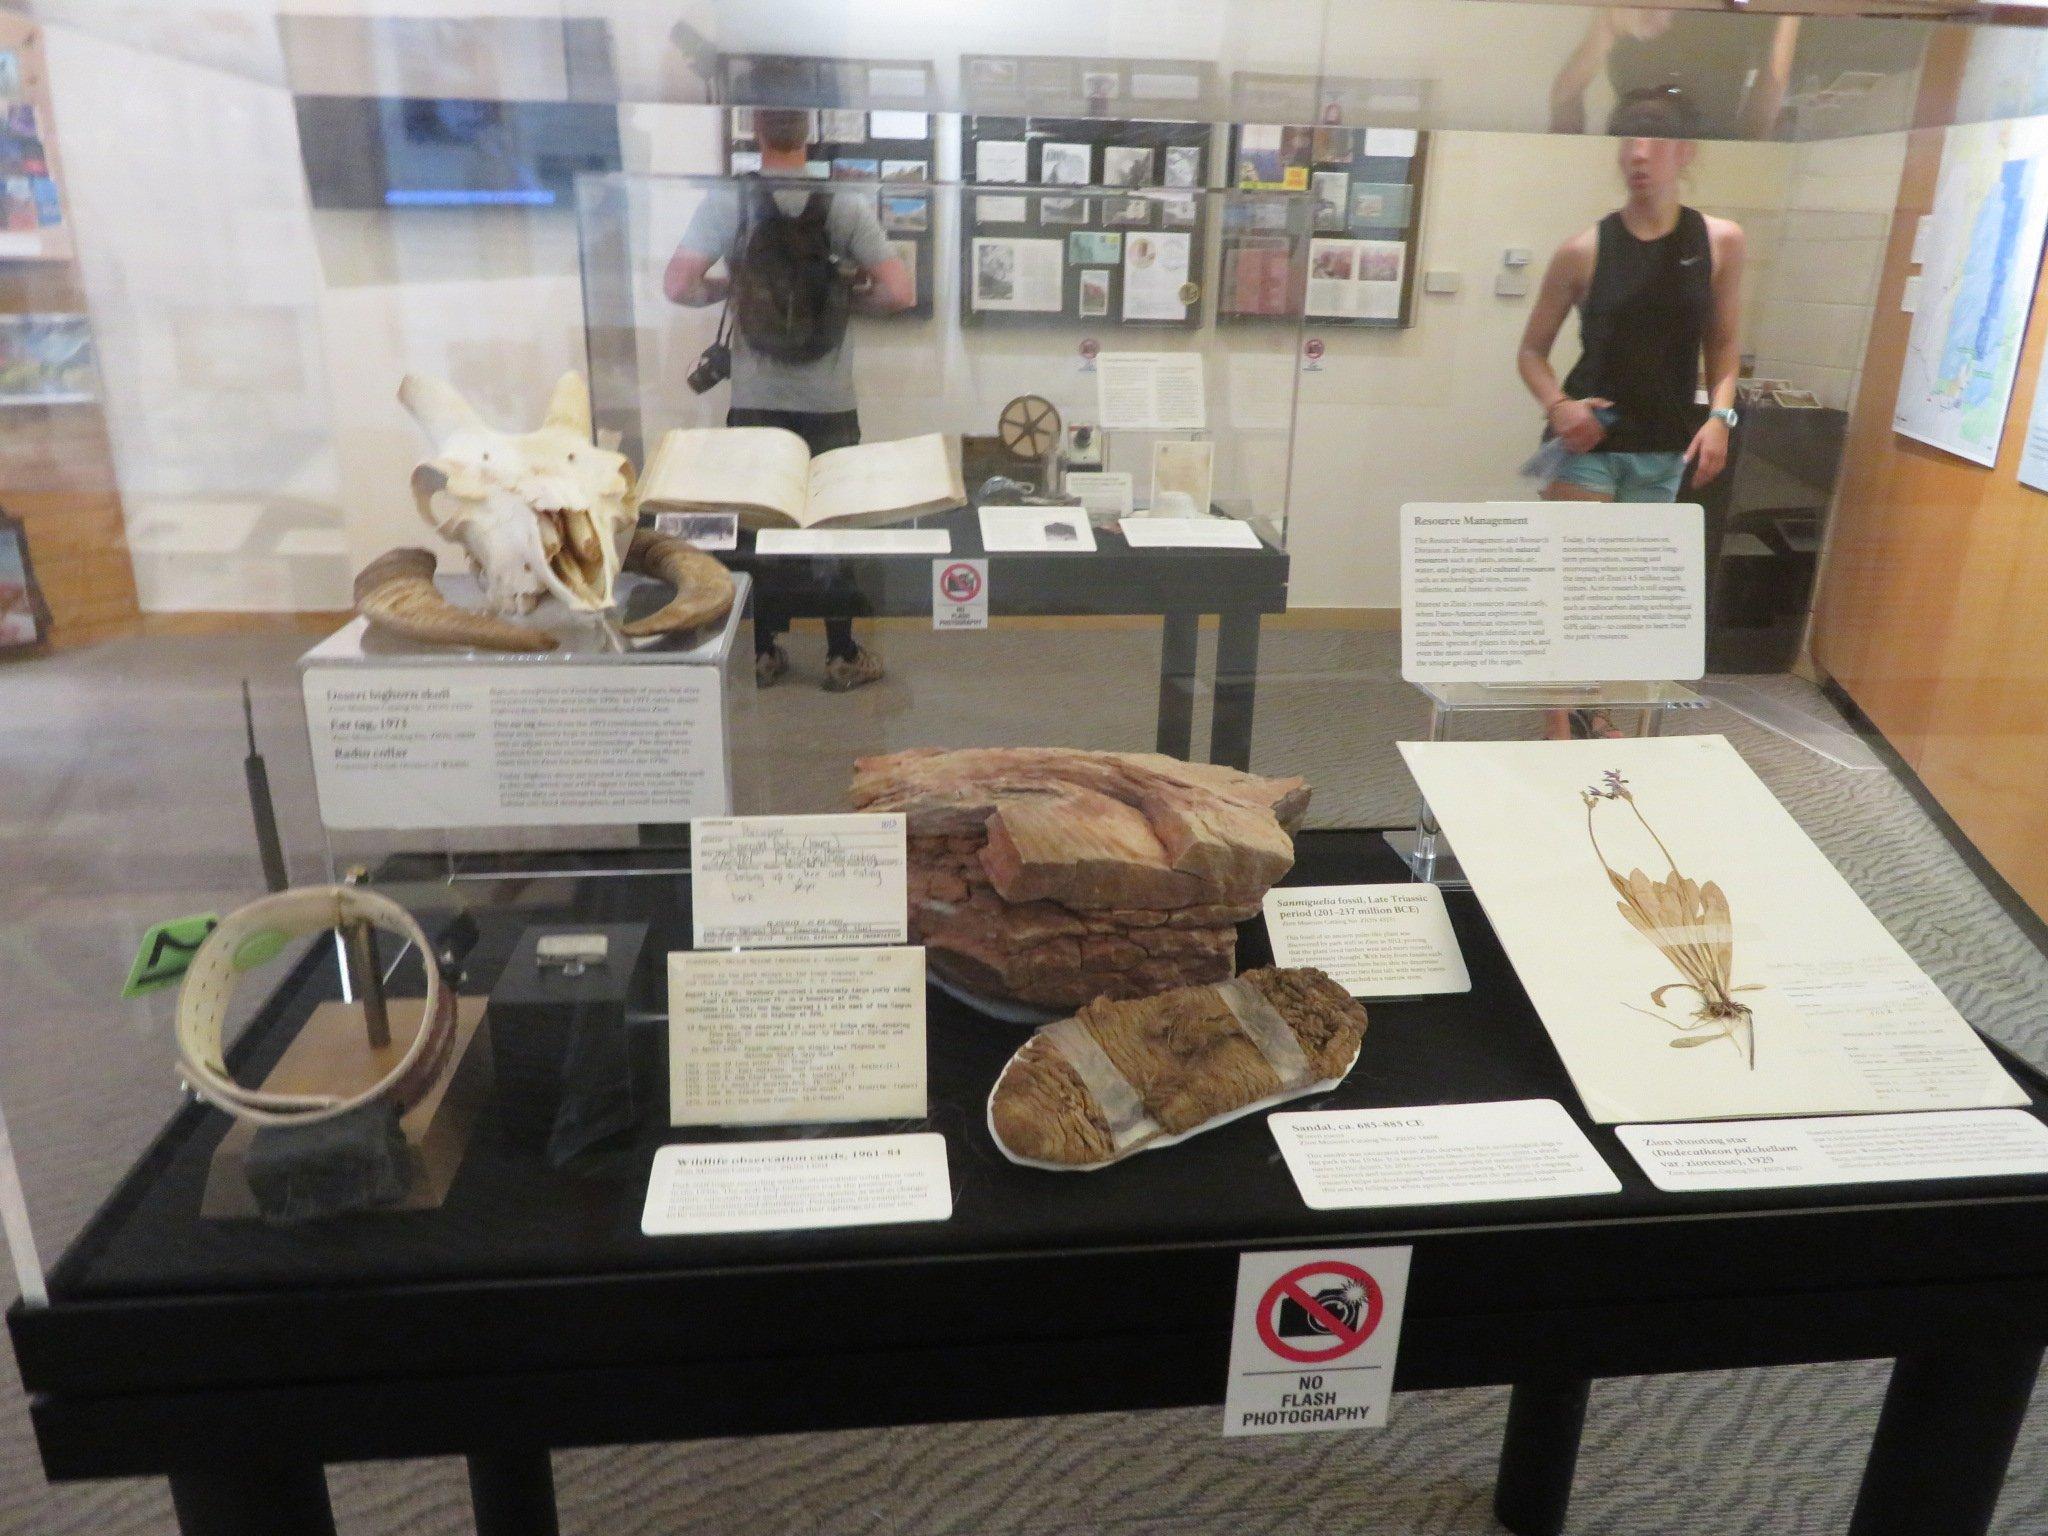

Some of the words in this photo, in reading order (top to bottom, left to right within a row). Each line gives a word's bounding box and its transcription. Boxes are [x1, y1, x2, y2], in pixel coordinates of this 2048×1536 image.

[1414, 516, 1460, 526] Resource
[1464, 516, 1528, 528] Management
[370, 688, 418, 702] bighorn
[421, 688, 450, 700] skull
[1276, 898, 1336, 908] Sanmiguelia
[1338, 896, 1366, 906] fossil,
[1368, 896, 1388, 904] Late
[1391, 894, 1428, 903] Triassic
[1280, 910, 1312, 920] period
[1358, 906, 1392, 915] million
[1394, 906, 1420, 914] BCE)
[1292, 1124, 1336, 1132] Sandal,
[1674, 1137, 1724, 1146] shooting
[1652, 1147, 1732, 1157] (Dodecatheon
[1734, 1144, 1798, 1156] pulchellum
[677, 1157, 728, 1166] Wildlife
[732, 1155, 807, 1165] observation
[810, 1152, 848, 1162] cards,
[1686, 1158, 1745, 1167] zionense),
[1748, 1156, 1774, 1164] 1929
[1299, 1376, 1323, 1390] NO
[1281, 1392, 1336, 1407] FLASH
[1242, 1406, 1370, 1426] PHOTOGRAPHY
